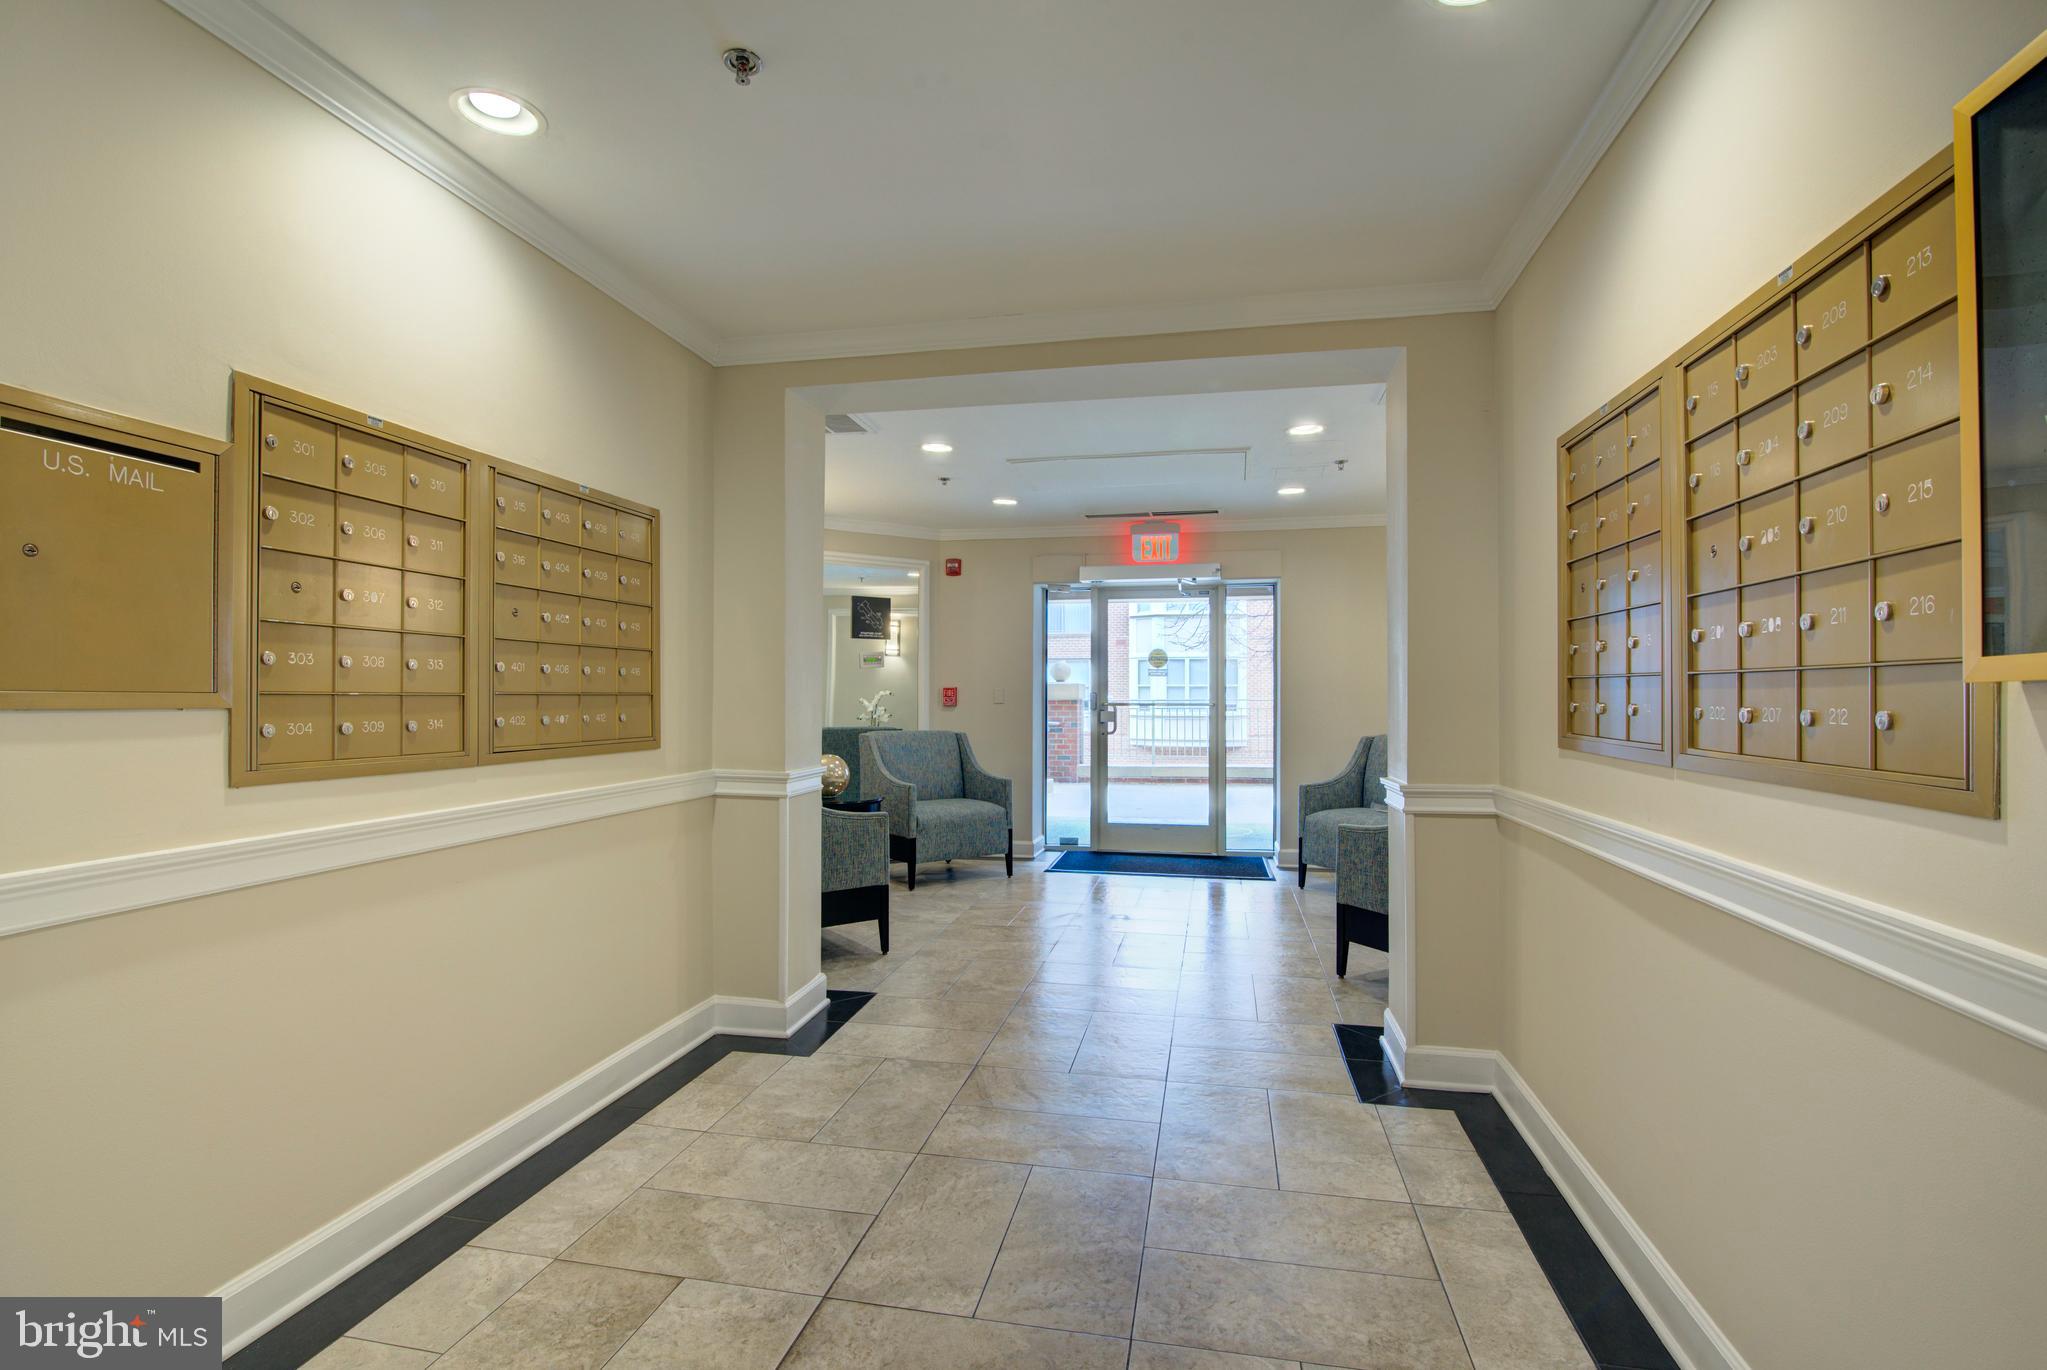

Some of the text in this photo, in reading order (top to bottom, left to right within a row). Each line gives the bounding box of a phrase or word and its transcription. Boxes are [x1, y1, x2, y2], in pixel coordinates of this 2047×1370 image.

[1906, 246, 1933, 279] 213
[1822, 301, 1847, 330] 208
[1906, 361, 1934, 391] 214
[1823, 403, 1849, 429] 209
[293, 442, 315, 458] 301
[1759, 435, 1779, 457] 204
[42, 448, 165, 492] U.S. MAIL
[364, 460, 387, 477] 305
[430, 478, 446, 493] 310
[1907, 478, 1934, 505] 215
[513, 502, 527, 513] 315
[288, 510, 316, 527] 302
[555, 511, 570, 524] 403
[1826, 505, 1848, 526] 210
[363, 525, 386, 540] 306
[1760, 526, 1781, 545] 205
[430, 538, 444, 552] 311
[1140, 534, 1172, 561] EXIT
[512, 554, 526, 566] 316
[555, 561, 570, 573] 404
[363, 590, 385, 605] 307
[427, 599, 444, 612] 312
[1908, 595, 1936, 616] 216
[1830, 607, 1847, 625] 211
[287, 652, 314, 666] 303
[362, 656, 385, 668] 308
[427, 659, 444, 671] 313
[510, 662, 525, 673] 401
[509, 715, 526, 727] 402
[555, 713, 569, 725] 407
[1709, 706, 1727, 721] 202
[1762, 706, 1782, 723] 207
[1828, 708, 1849, 726] 212
[286, 722, 313, 736] 304
[362, 720, 385, 733] 309
[427, 719, 444, 730] 314
